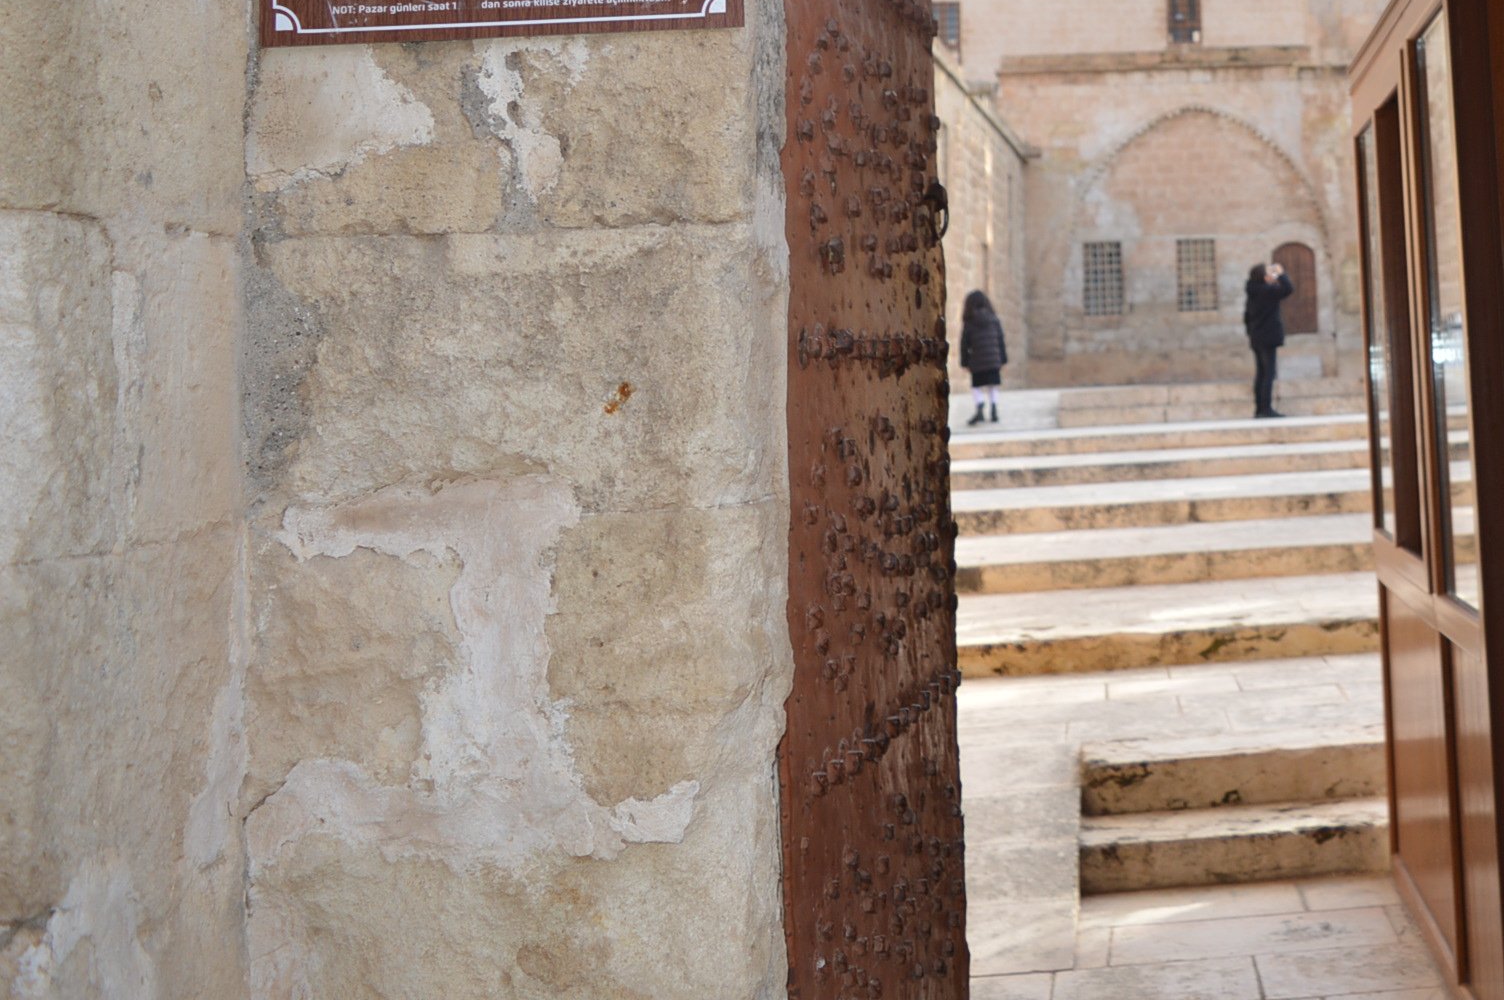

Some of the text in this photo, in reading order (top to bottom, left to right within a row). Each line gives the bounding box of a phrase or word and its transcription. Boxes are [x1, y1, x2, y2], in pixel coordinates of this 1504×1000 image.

[332, 5, 357, 15] NOT:
[358, 3, 388, 14] Pazar
[427, 0, 451, 11] saat
